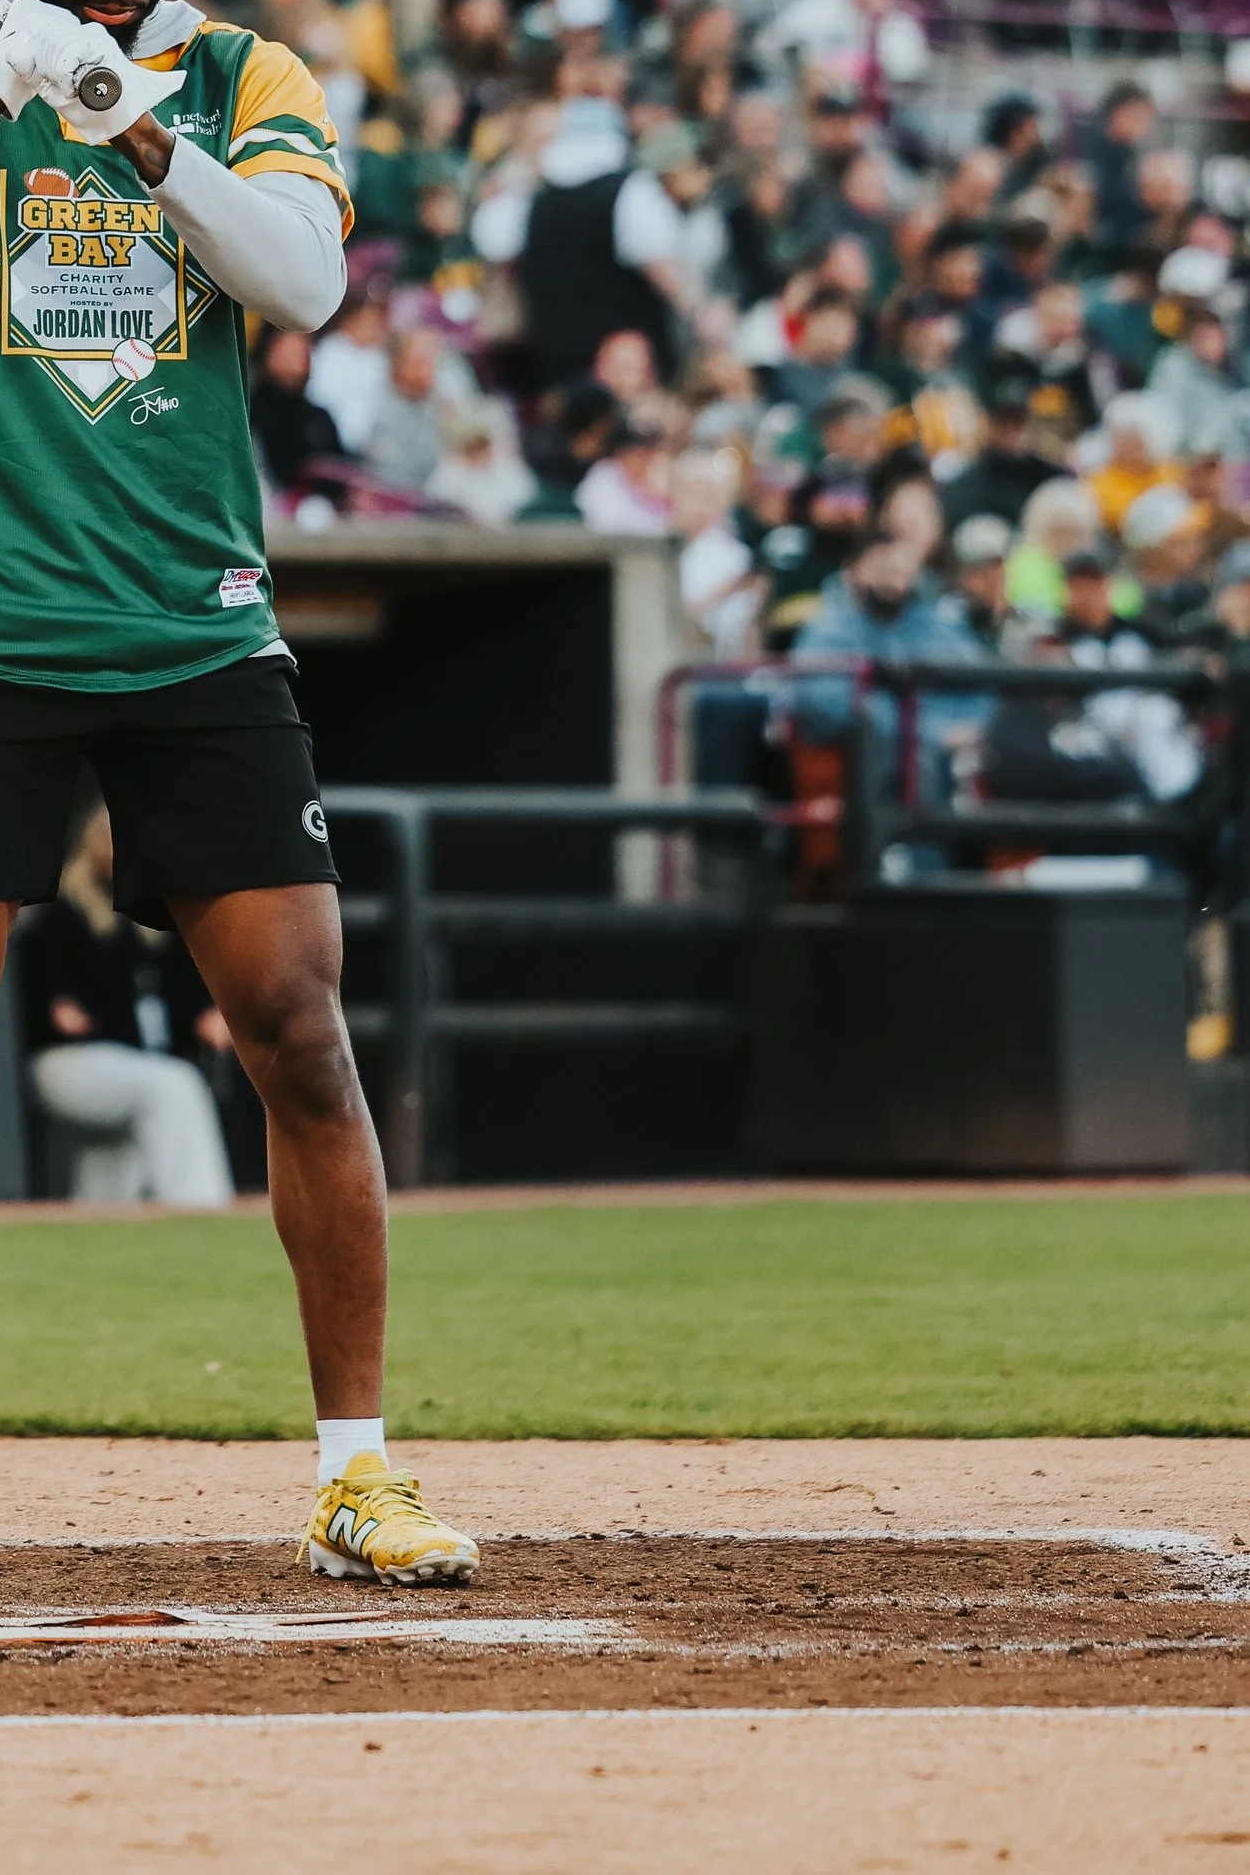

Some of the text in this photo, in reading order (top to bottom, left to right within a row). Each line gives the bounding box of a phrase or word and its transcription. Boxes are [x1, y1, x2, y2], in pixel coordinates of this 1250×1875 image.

[22, 198, 161, 233] GREEN
[49, 234, 136, 266] BAY
[30, 285, 155, 296] SOFTBALL GAME
[60, 273, 124, 284] CHARITY
[32, 309, 154, 339] JORDAN LOVE
[303, 803, 328, 841] G
[327, 1503, 381, 1557] N
